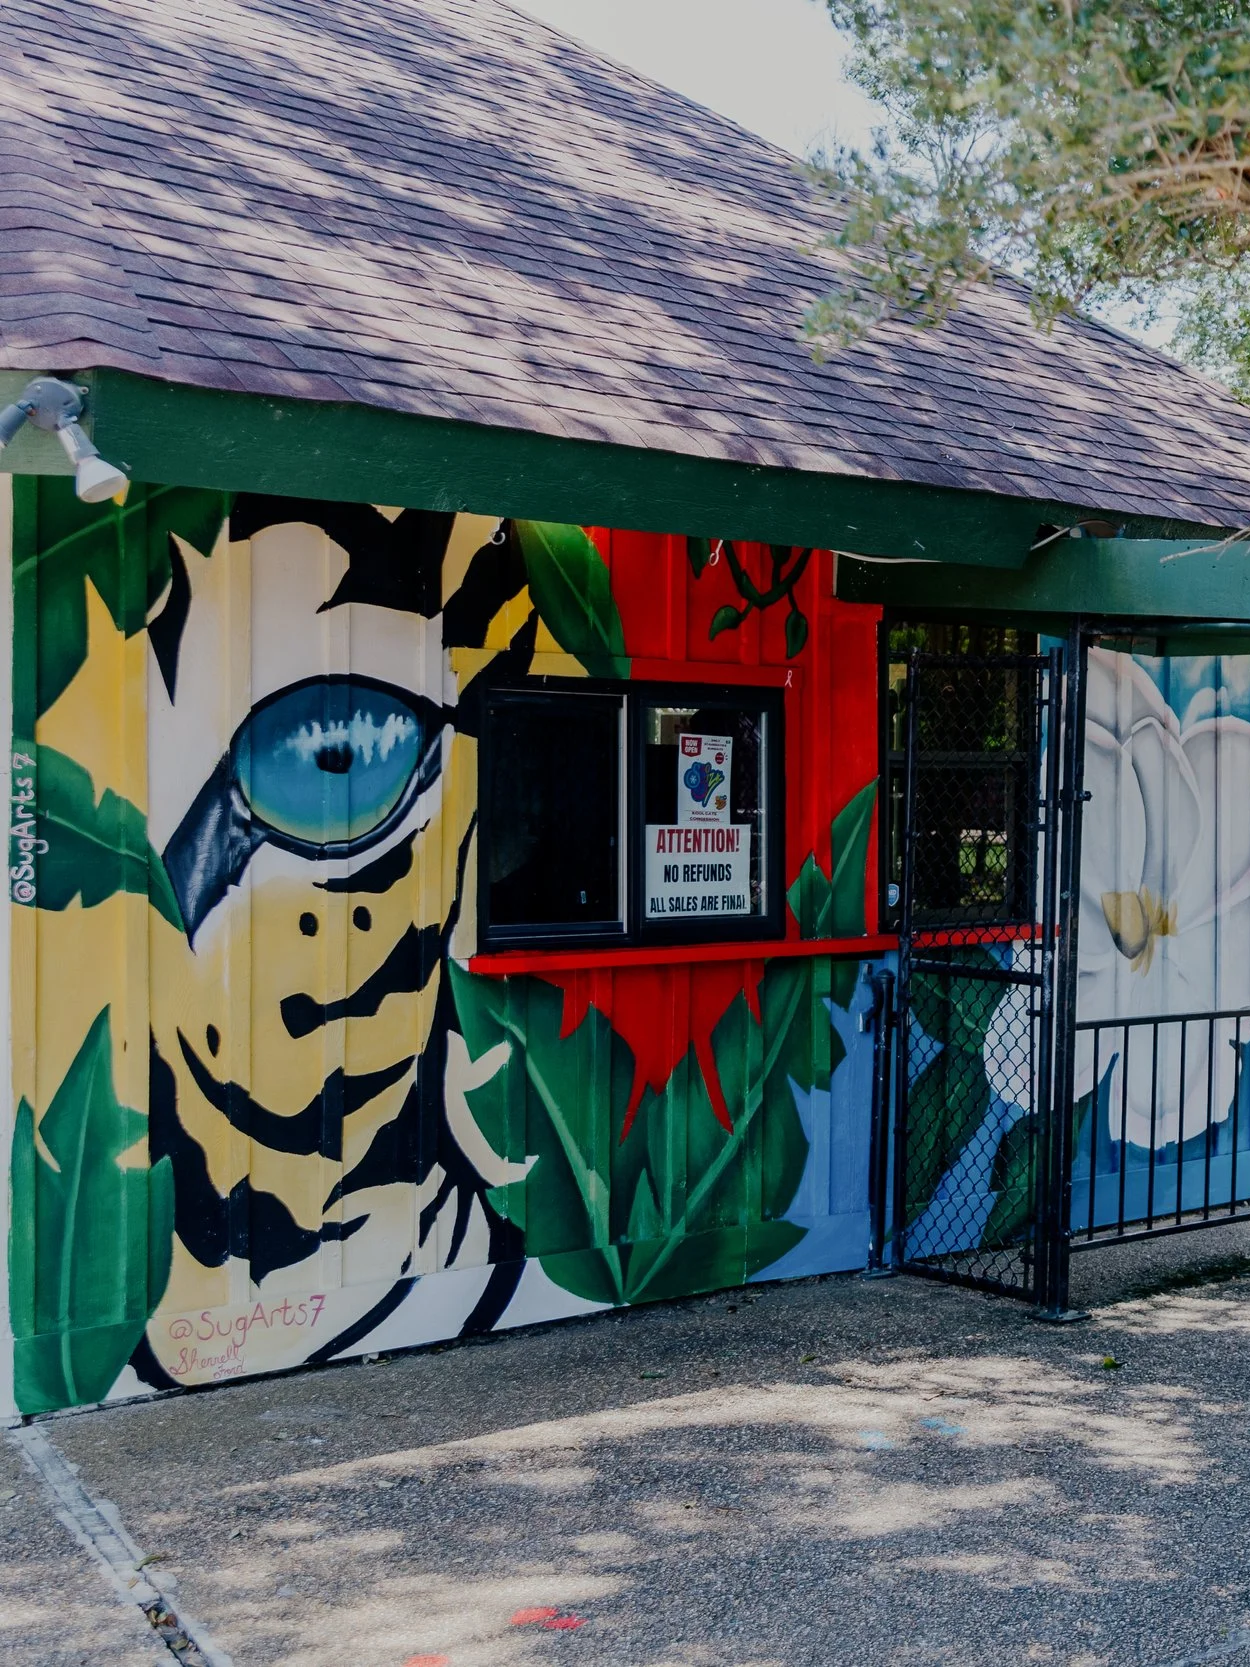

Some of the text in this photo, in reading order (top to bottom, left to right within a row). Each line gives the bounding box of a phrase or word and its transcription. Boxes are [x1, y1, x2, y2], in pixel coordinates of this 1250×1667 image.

[656, 828, 740, 853] ATTENTION!
[663, 863, 732, 883] NO REFUNDS
[650, 894, 747, 913] ALL SALES ARE FINAL
[168, 1294, 327, 1348] @SugArts7
